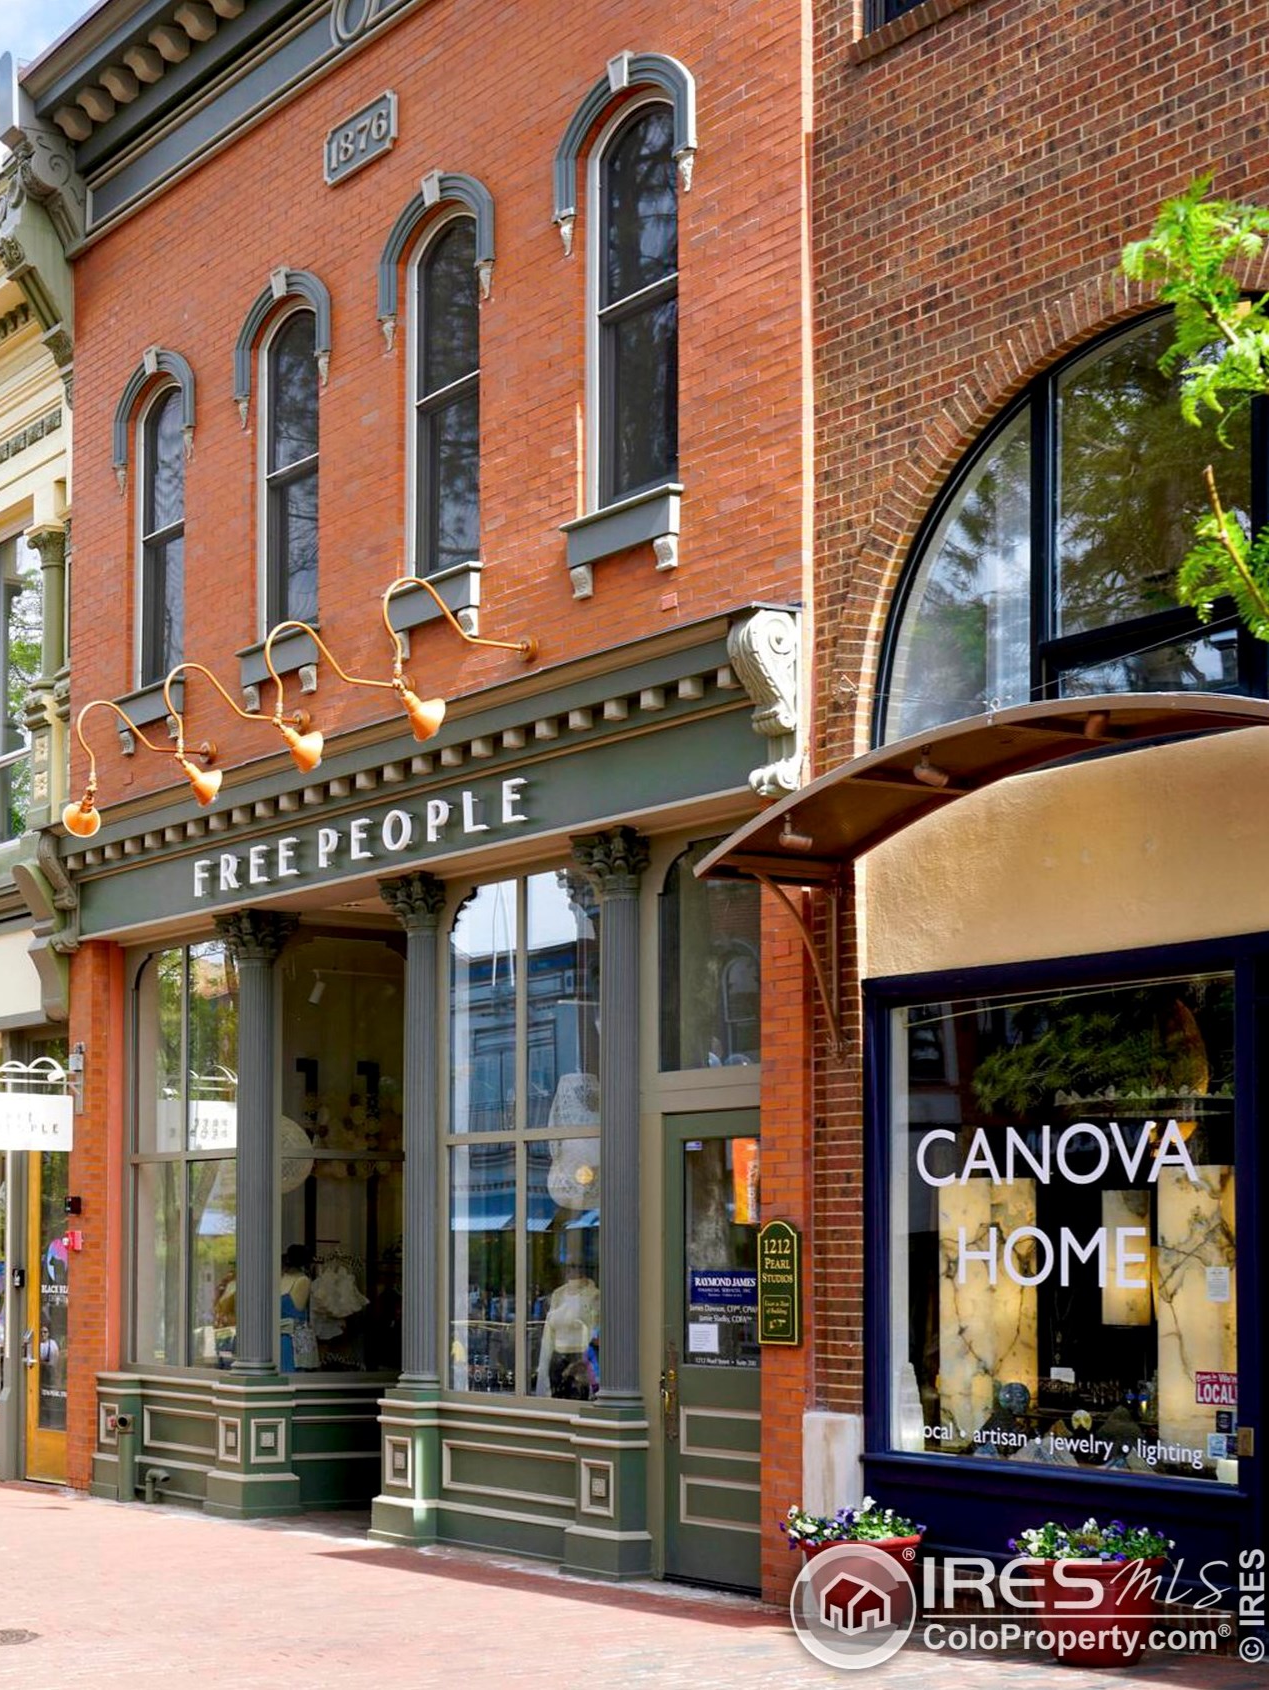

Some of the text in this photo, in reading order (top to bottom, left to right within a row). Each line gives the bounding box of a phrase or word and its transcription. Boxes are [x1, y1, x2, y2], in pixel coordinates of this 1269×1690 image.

[331, 110, 388, 171] 1876
[194, 777, 528, 897] FREE PEOPLE
[916, 1119, 1199, 1187] CANOVA
[764, 1239, 791, 1254] 1212
[957, 1225, 1146, 1288] HOME
[694, 1277, 731, 1287] RAYMOND
[922, 1423, 953, 1441] ocal
[973, 1427, 1028, 1448] artisan
[1049, 1433, 1114, 1461] jewelry
[1137, 1438, 1204, 1470] lighting
